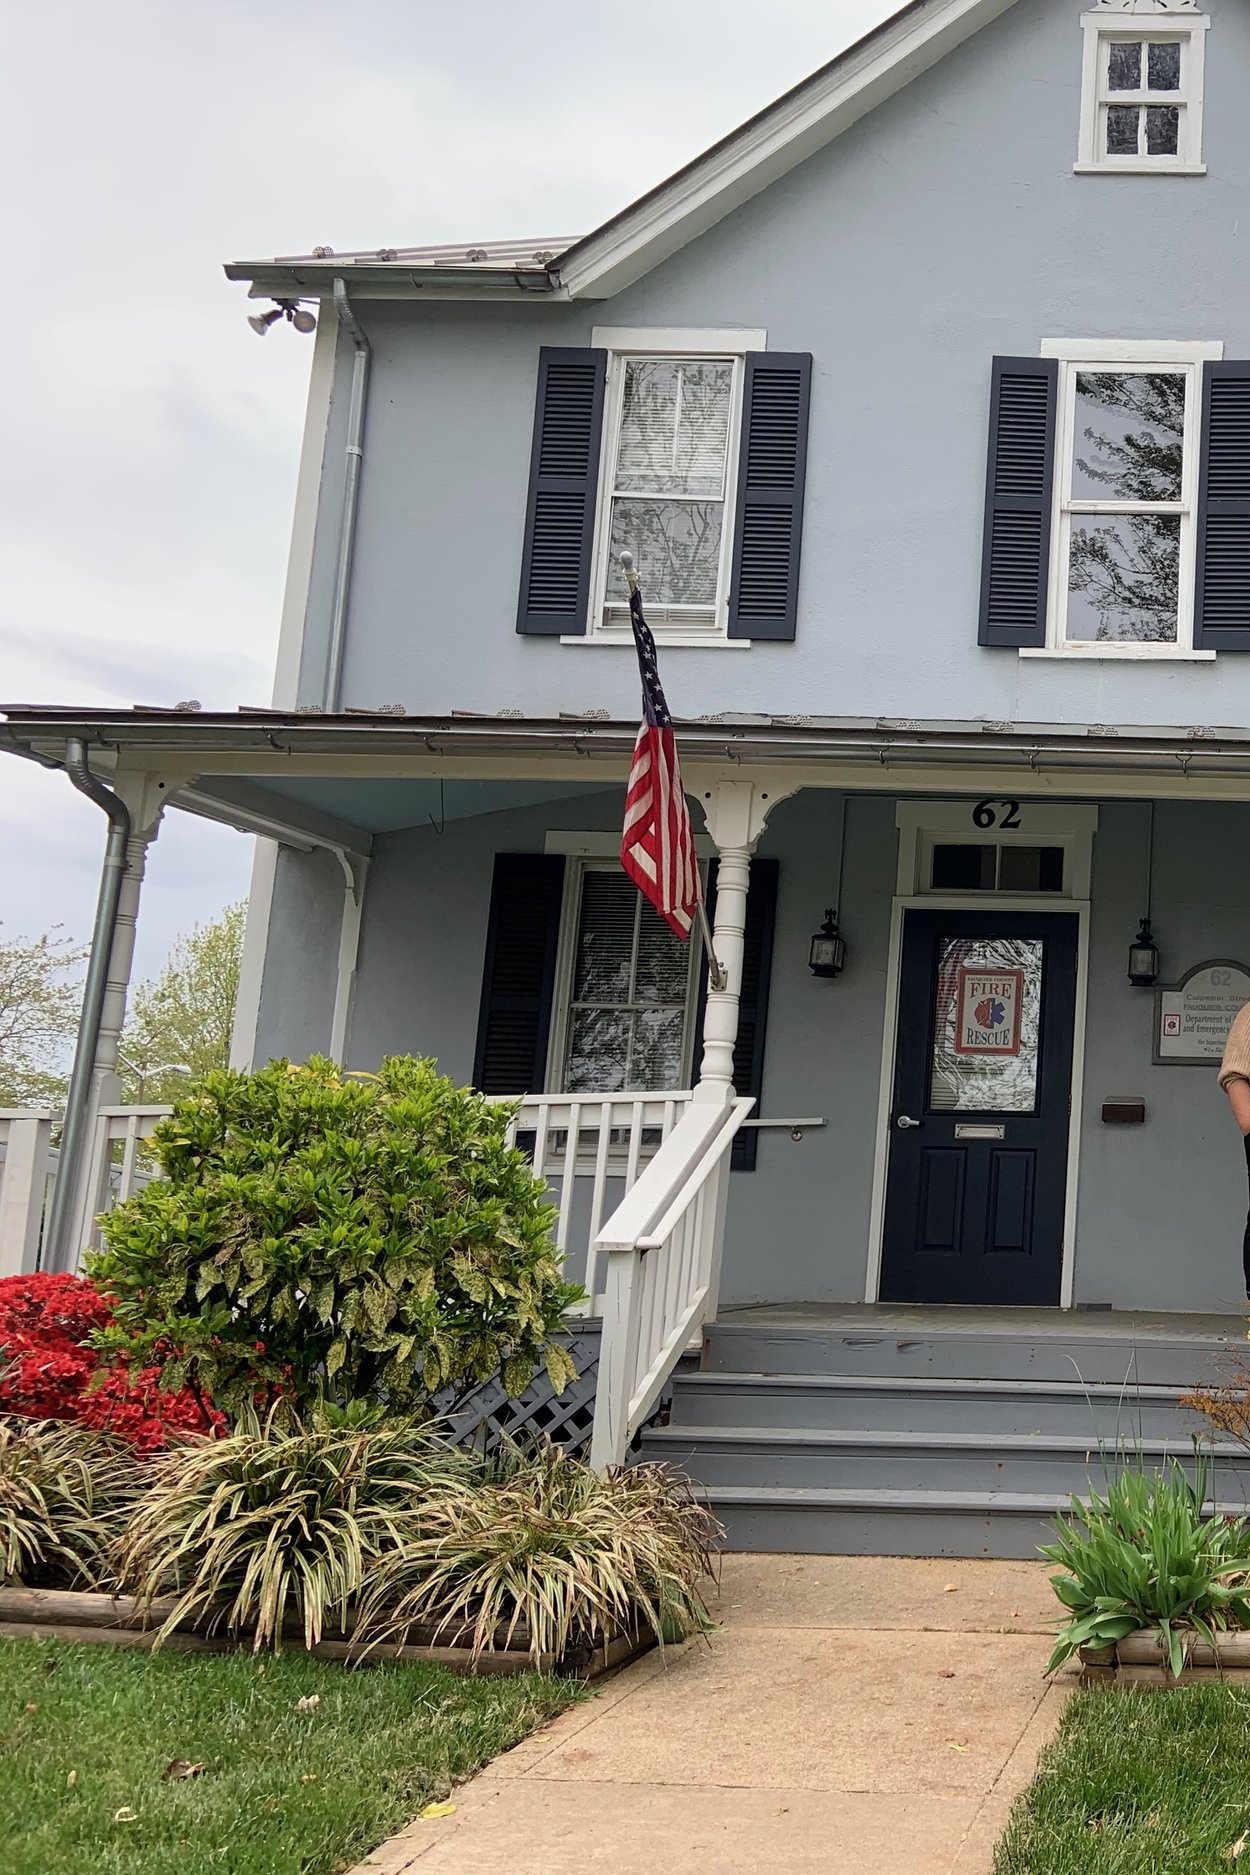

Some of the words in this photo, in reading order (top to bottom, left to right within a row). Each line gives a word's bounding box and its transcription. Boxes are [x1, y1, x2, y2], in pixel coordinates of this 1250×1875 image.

[972, 799, 1022, 829] 62
[1210, 969, 1232, 987] 62
[969, 982, 1012, 999] FIRE
[1186, 993, 1224, 1002] Culpeper
[1185, 1014, 1223, 1025] Department
[1224, 1015, 1231, 1023] of
[966, 1027, 1010, 1046] RESCUE
[1183, 1024, 1194, 1033] and
